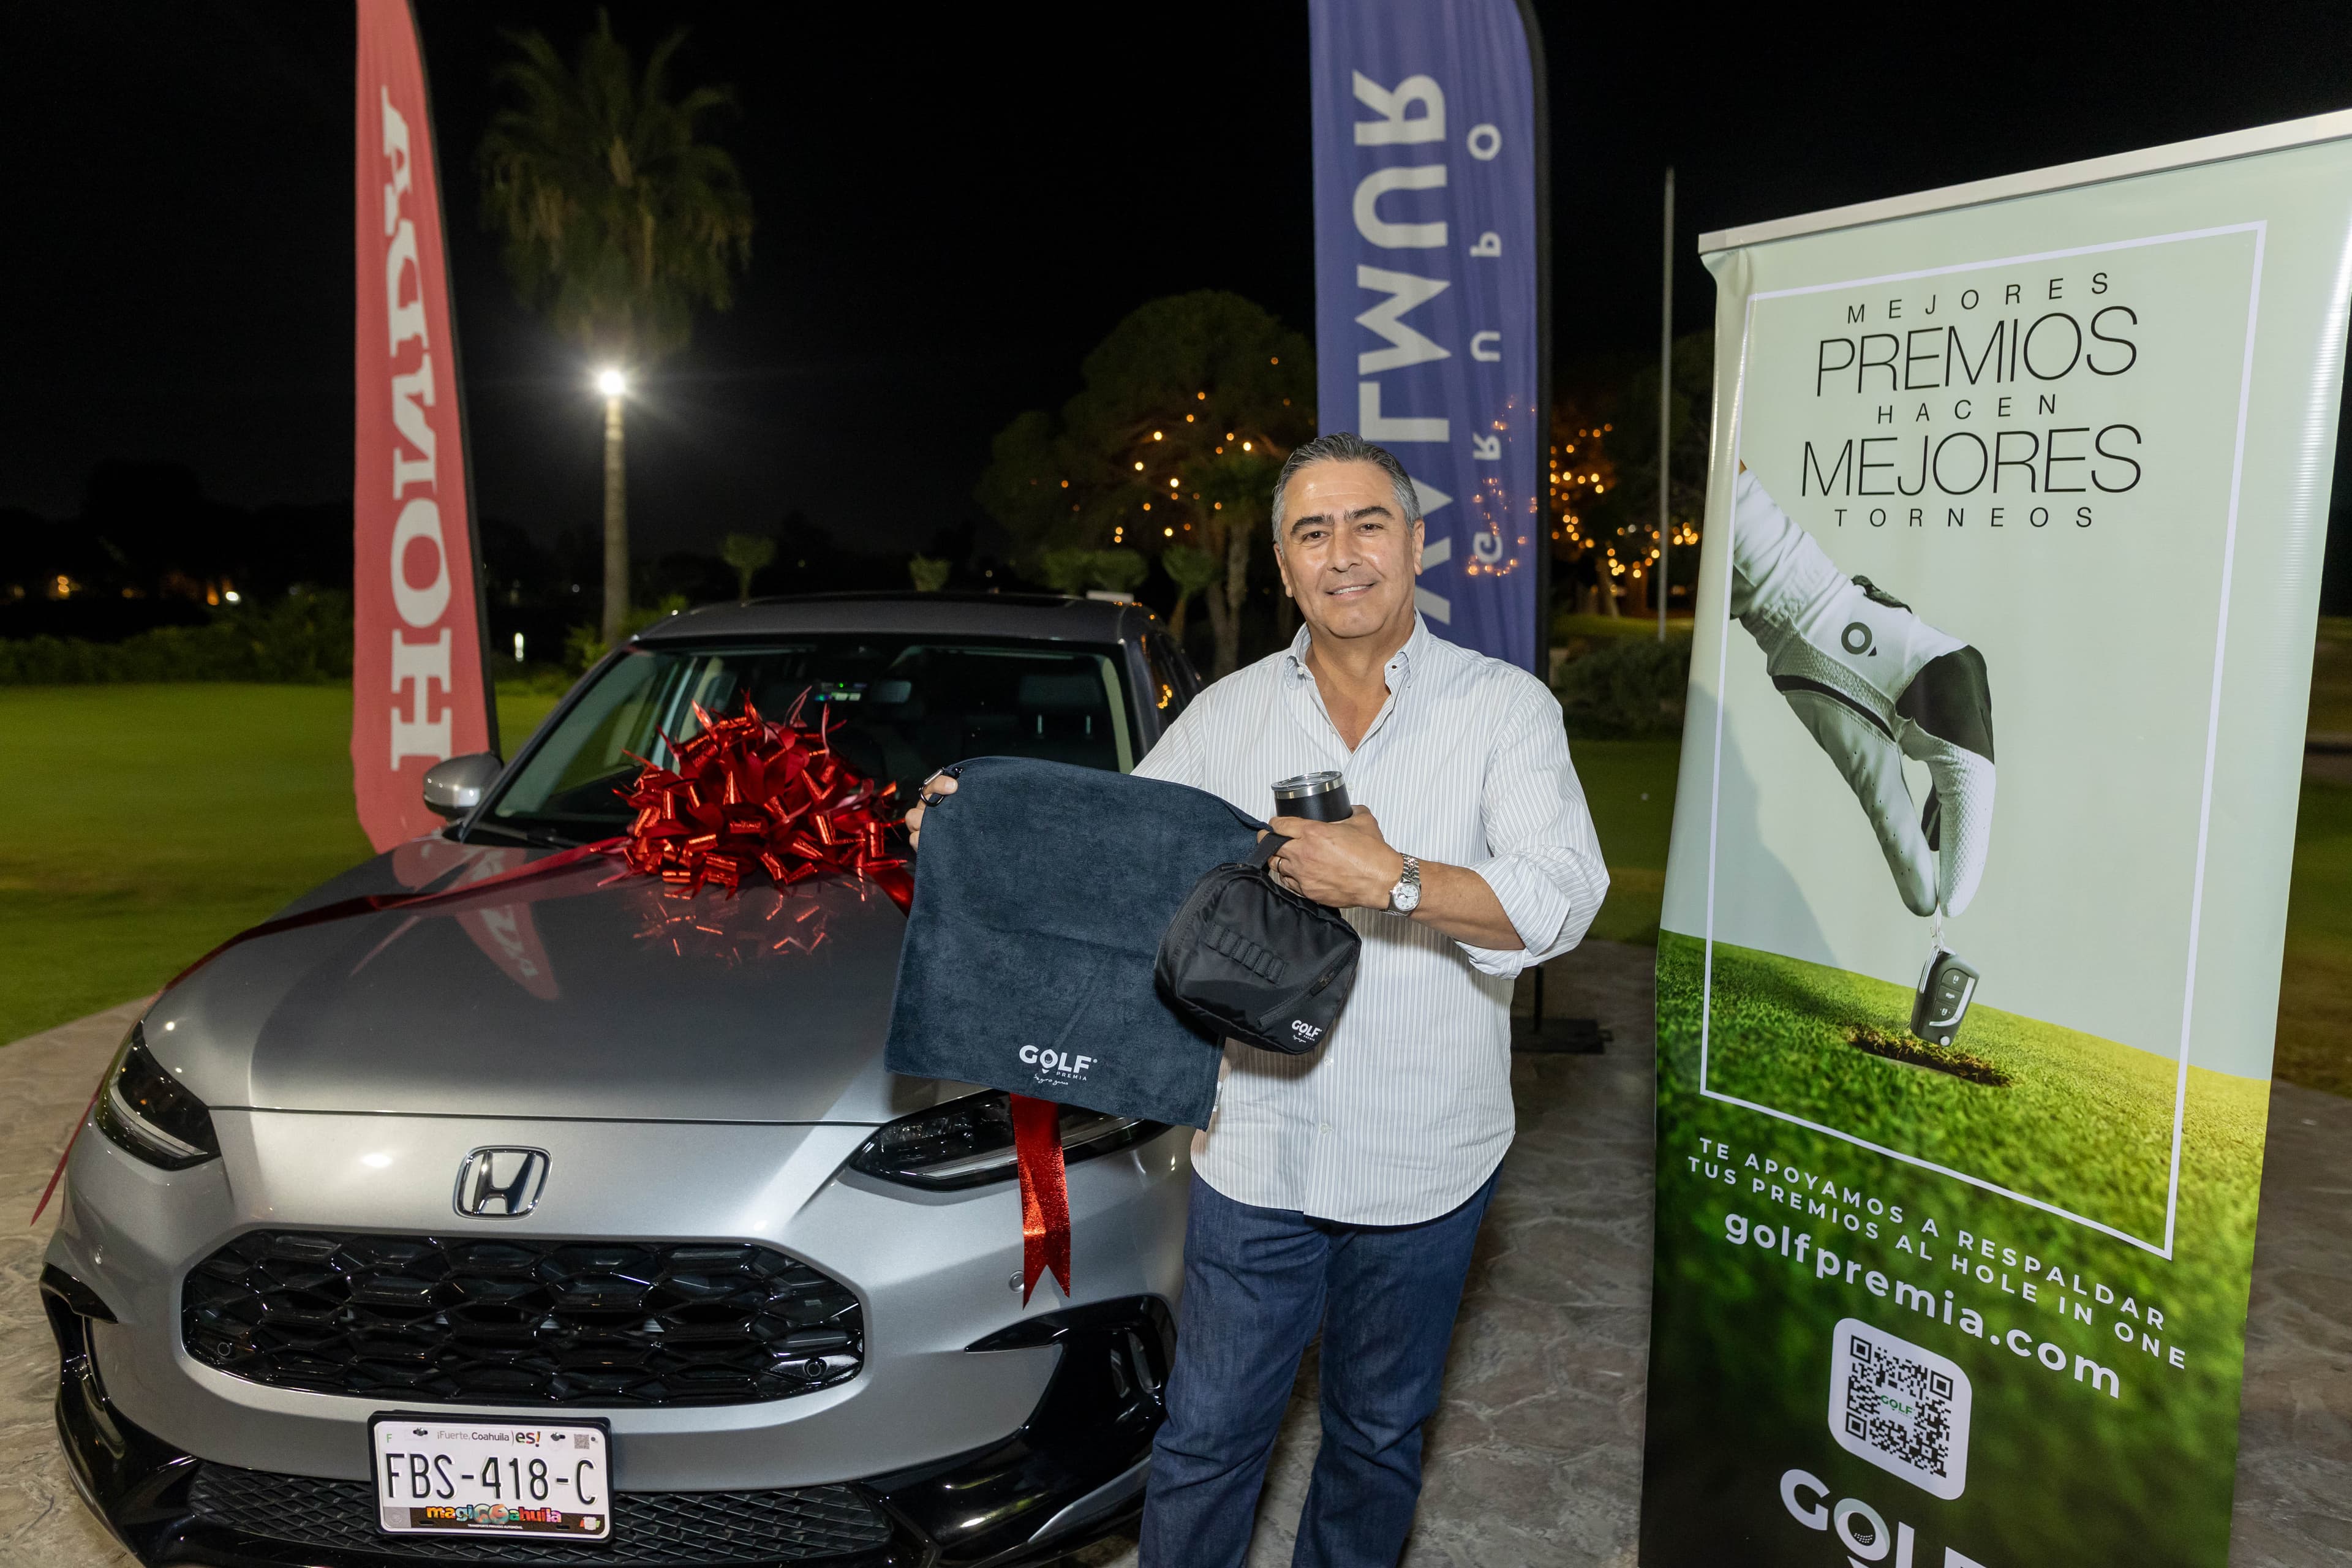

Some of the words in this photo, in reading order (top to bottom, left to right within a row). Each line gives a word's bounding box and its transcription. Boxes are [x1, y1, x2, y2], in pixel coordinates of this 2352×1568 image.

[1847, 272, 2108, 324] MEJORES
[1817, 306, 2138, 397] PREMIOS
[1877, 394, 2056, 424] HACEN
[1801, 424, 2142, 497] MEJORES
[1834, 507, 2092, 528] TORNEOS
[1291, 1020, 1321, 1038] GOLF
[1019, 1044, 1092, 1074] GOLF
[1056, 1071, 1087, 1081] PREMIA
[1699, 1137, 1728, 1160] TE
[1744, 1153, 1903, 1224] APOYAMOS
[1921, 1218, 1939, 1237] A
[1958, 1230, 2165, 1331] RESPALDAR
[1688, 1156, 1736, 1185] TUS
[1752, 1177, 1879, 1240] PREMIOS
[1895, 1235, 1932, 1261] AL
[1952, 1254, 2038, 1303] HOLE
[2059, 1296, 2093, 1326] IN
[2114, 1321, 2186, 1370] ONE
[1725, 1213, 2120, 1399] golfpremia.com
[1880, 1394, 1913, 1414] GOLF
[471, 1431, 510, 1441] Coahuila
[385, 1452, 597, 1505] FBS-418-C
